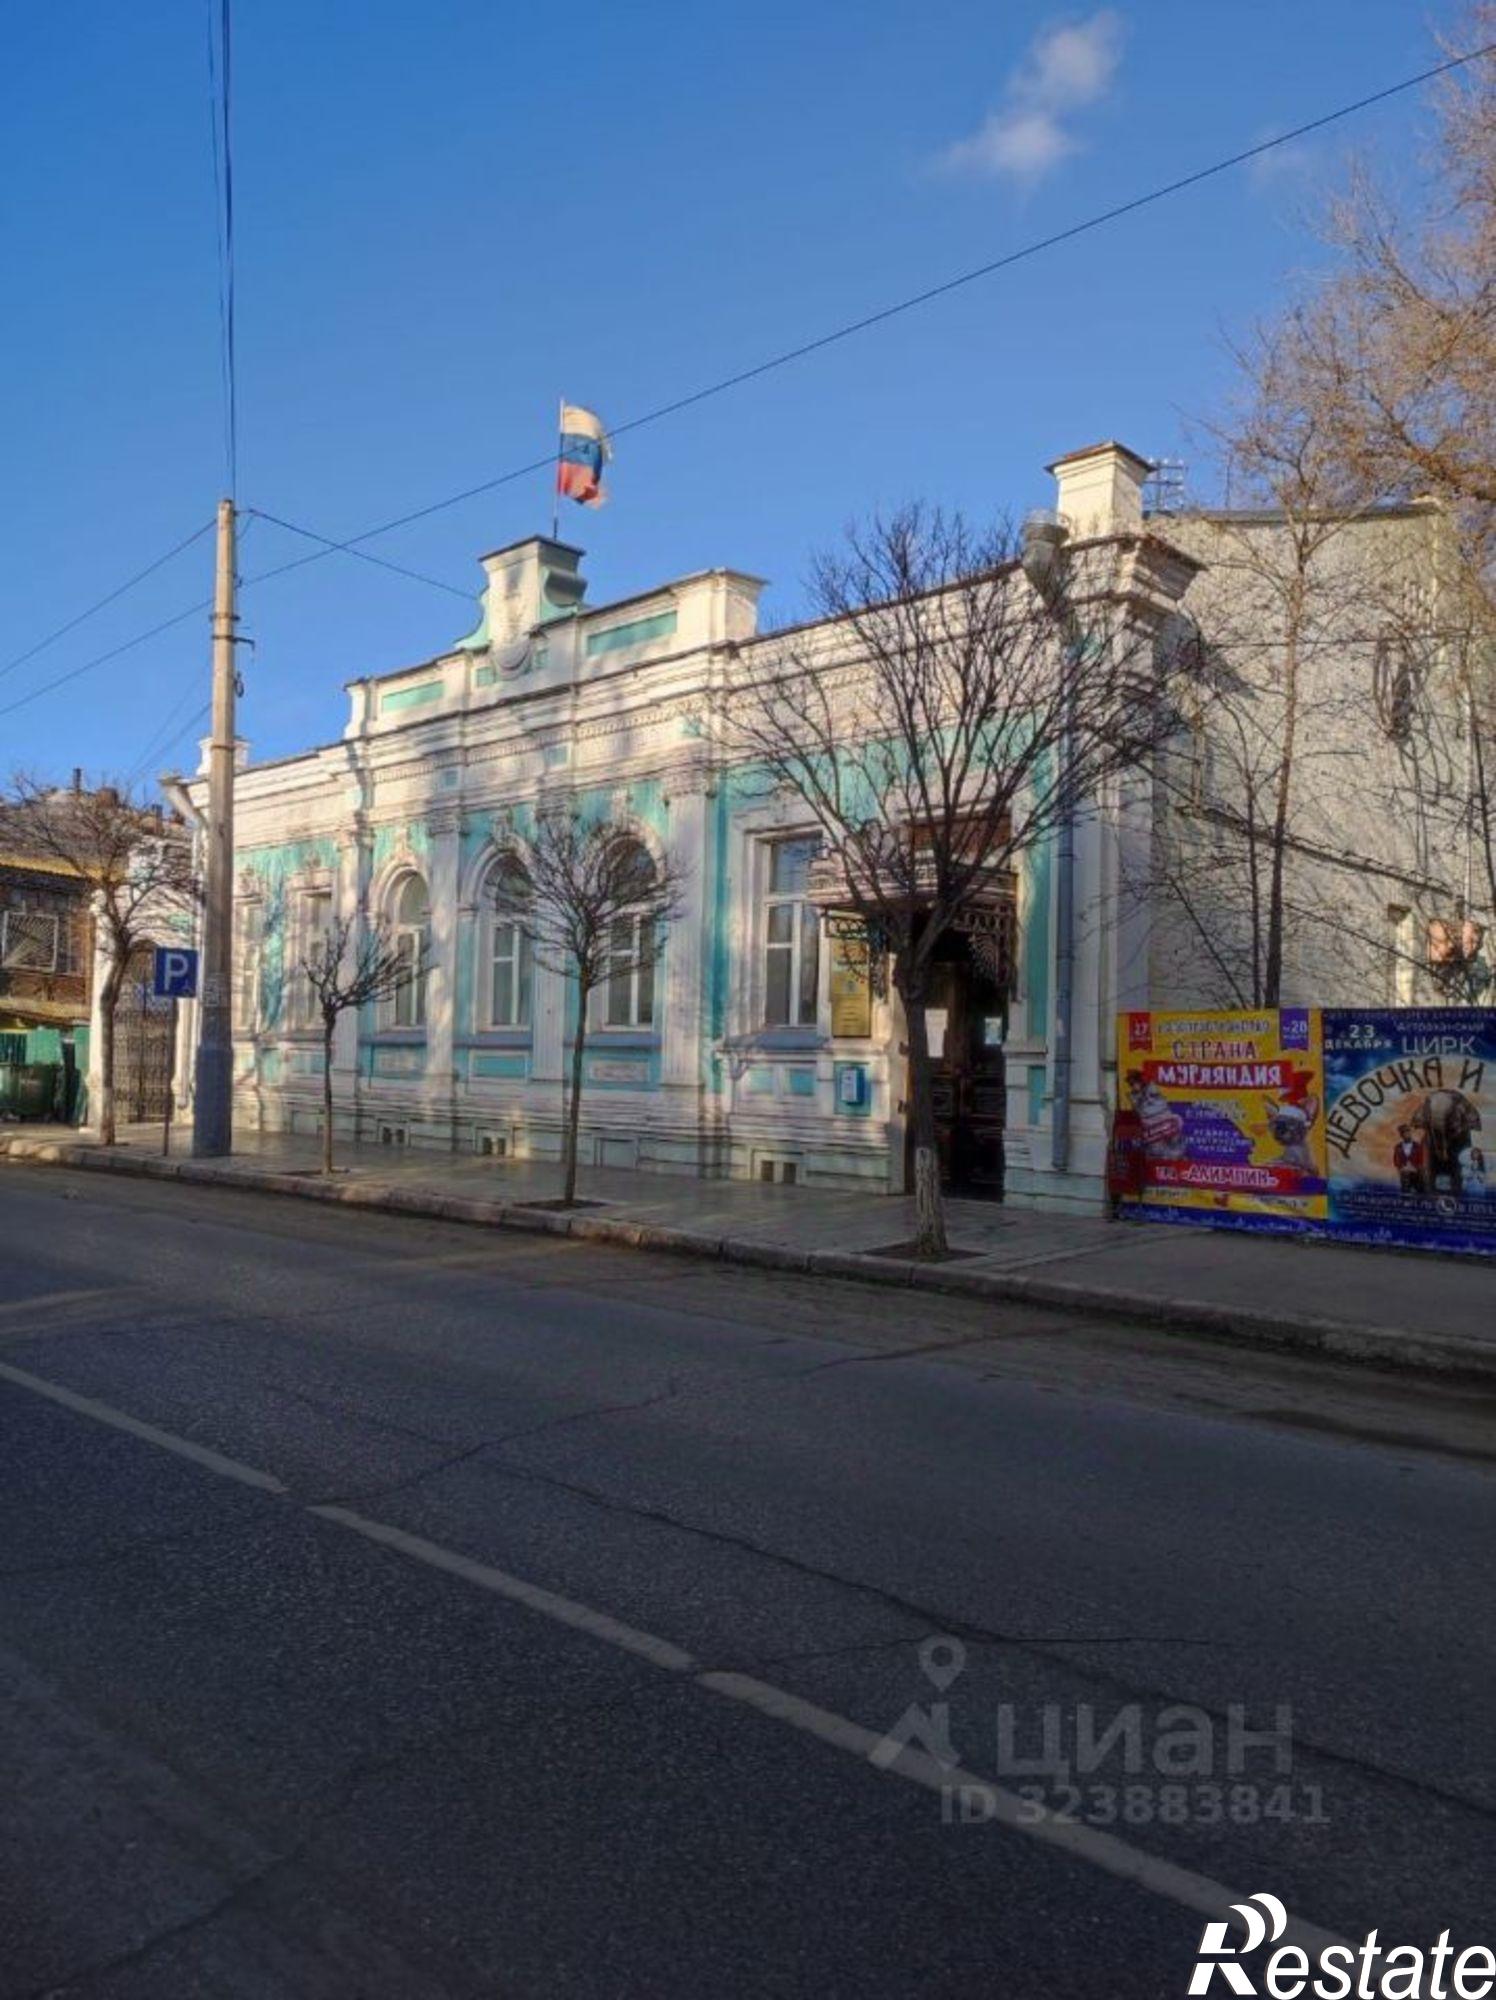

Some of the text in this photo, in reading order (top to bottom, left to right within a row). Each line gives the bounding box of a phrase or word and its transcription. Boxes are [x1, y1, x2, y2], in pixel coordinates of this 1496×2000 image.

[164, 952, 189, 992] P
[1349, 1024, 1375, 1039] 23
[1172, 1040, 1257, 1060] СТРАНА
[1324, 1039, 1393, 1050] ДЕКАБРЯ
[1401, 1035, 1476, 1055] ЦИРК
[1157, 1063, 1282, 1088] МУГЛЯНДИЯ
[1325, 1055, 1485, 1159] ДЕВОЧКА И
